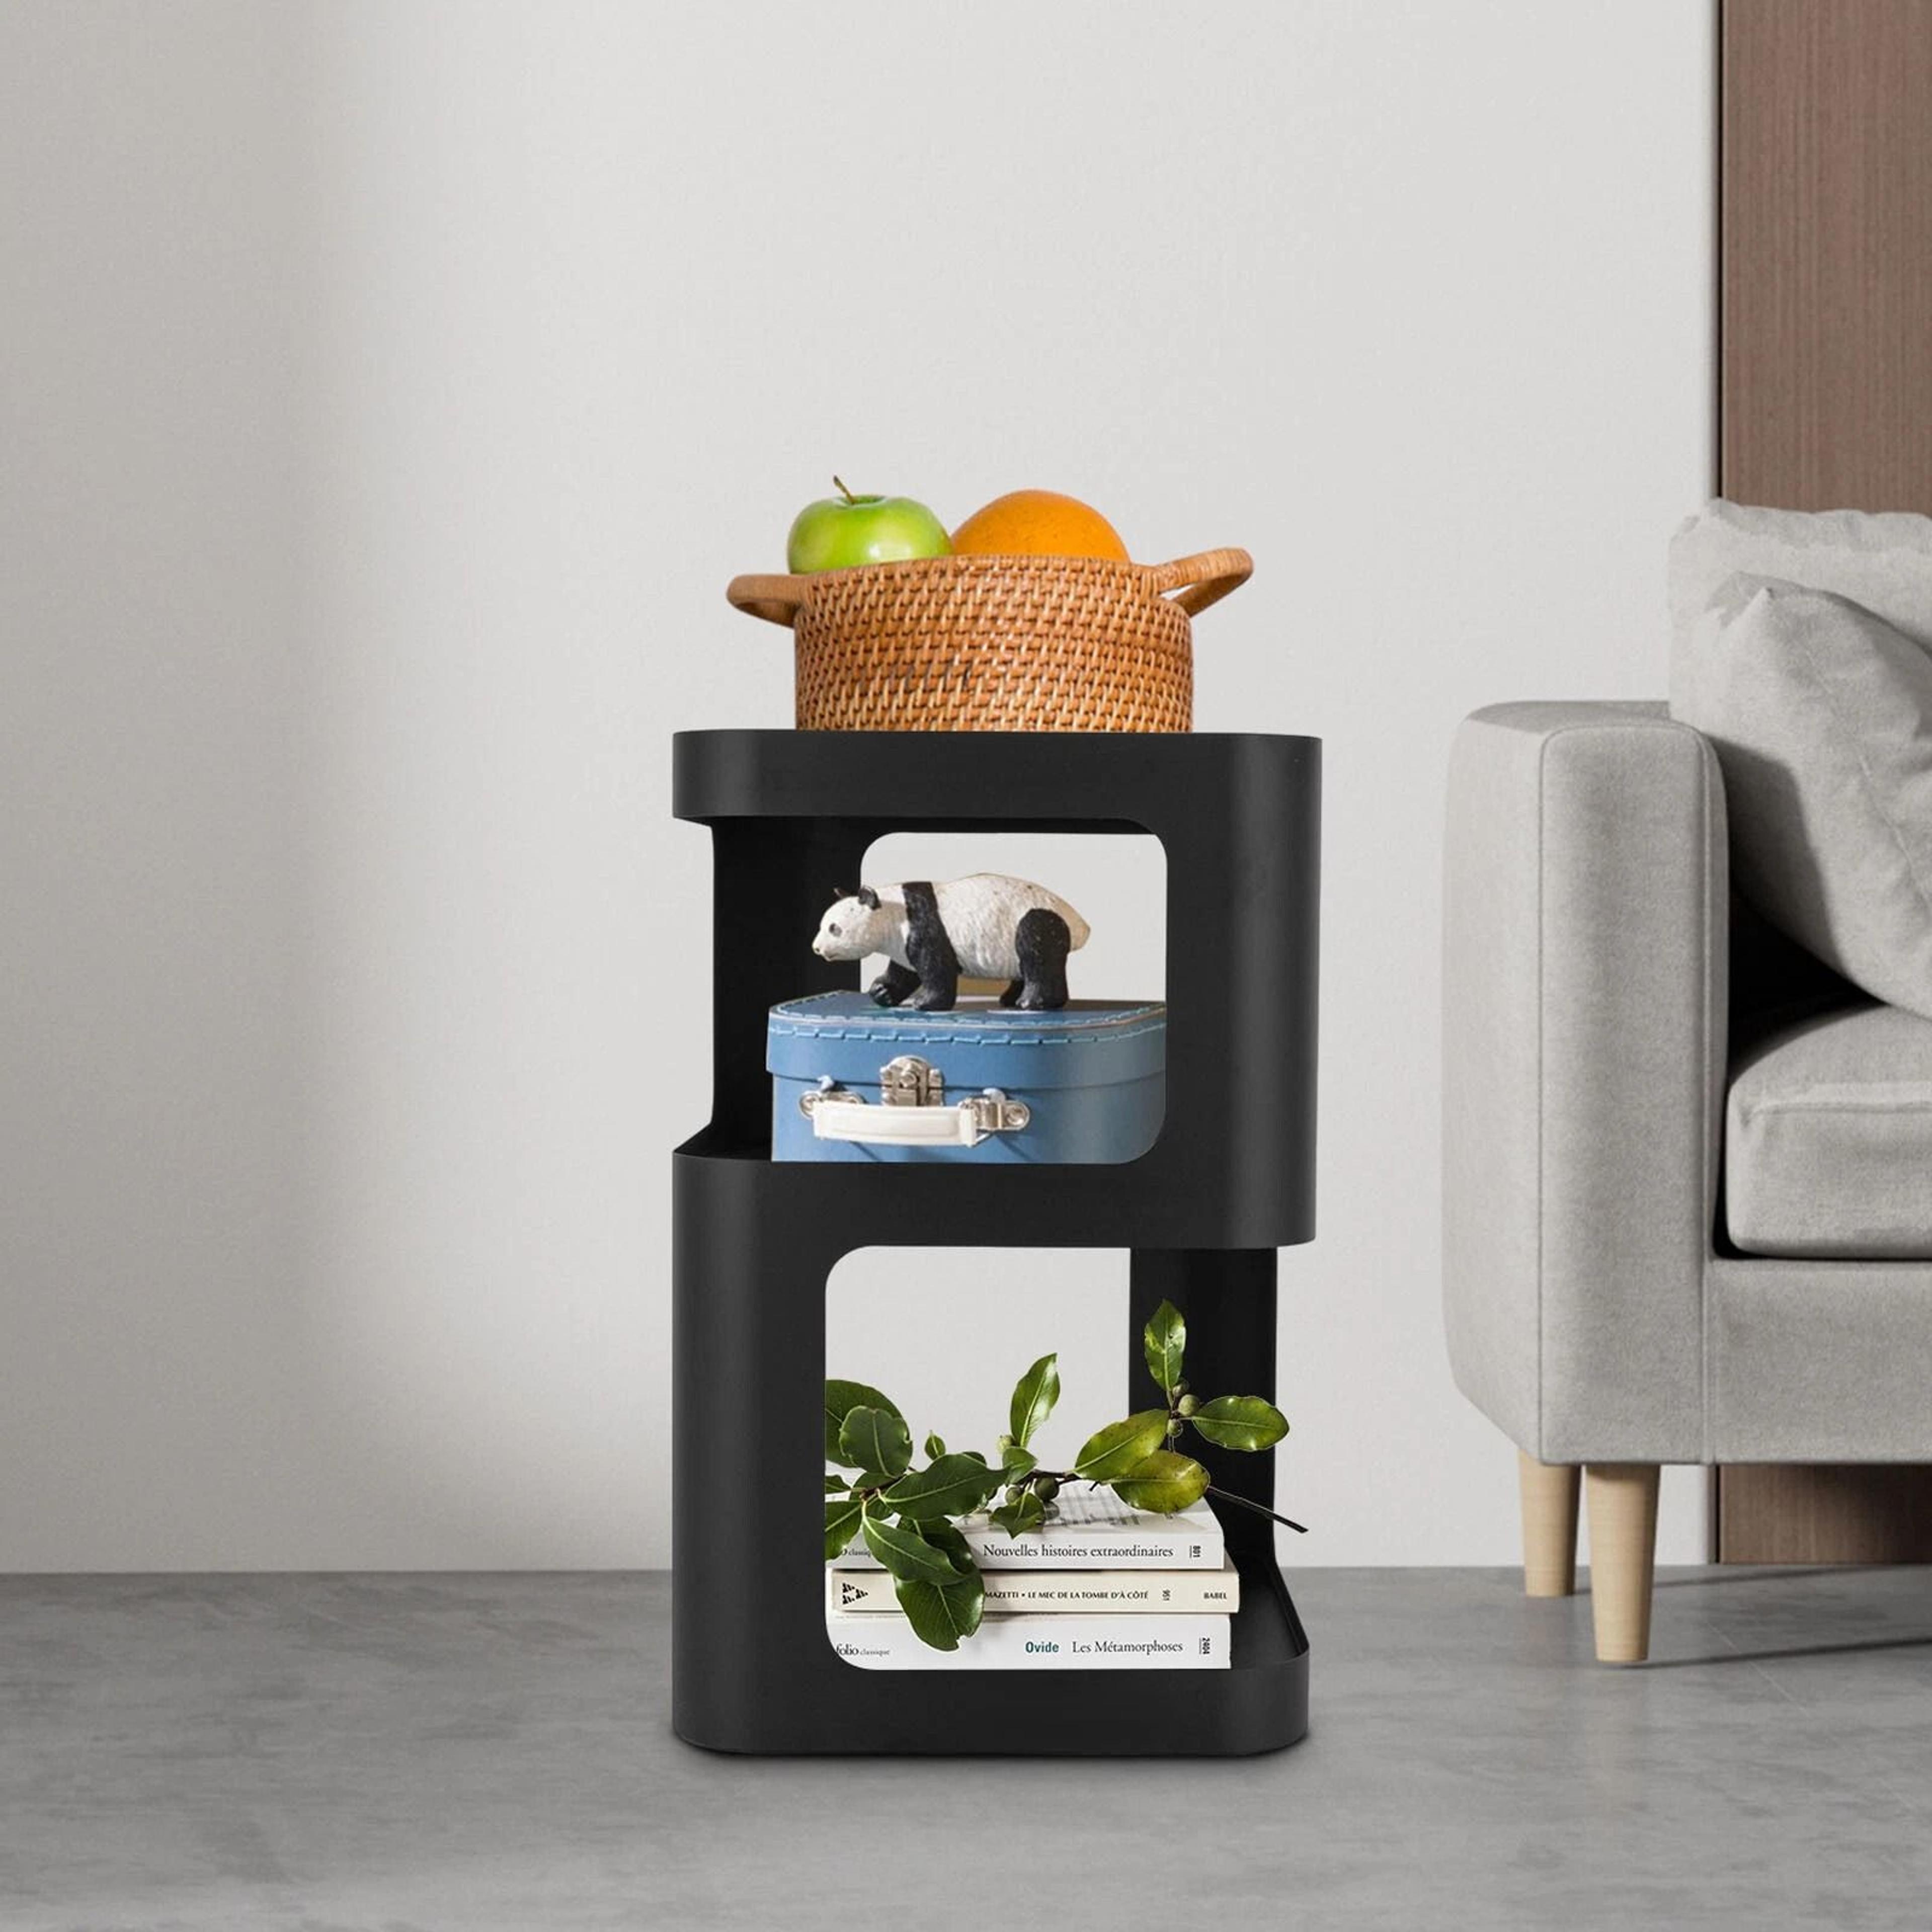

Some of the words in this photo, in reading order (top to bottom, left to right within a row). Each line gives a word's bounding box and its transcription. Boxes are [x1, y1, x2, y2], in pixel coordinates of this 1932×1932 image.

[984, 1544, 1038, 1557] Nouvelles
[1041, 1544, 1087, 1557] histoires
[1090, 1544, 1174, 1557] extraordinaires
[1025, 1641, 1060, 1653] Ovide
[1072, 1641, 1092, 1654] Les
[1094, 1639, 1183, 1655] Métamorphoses
